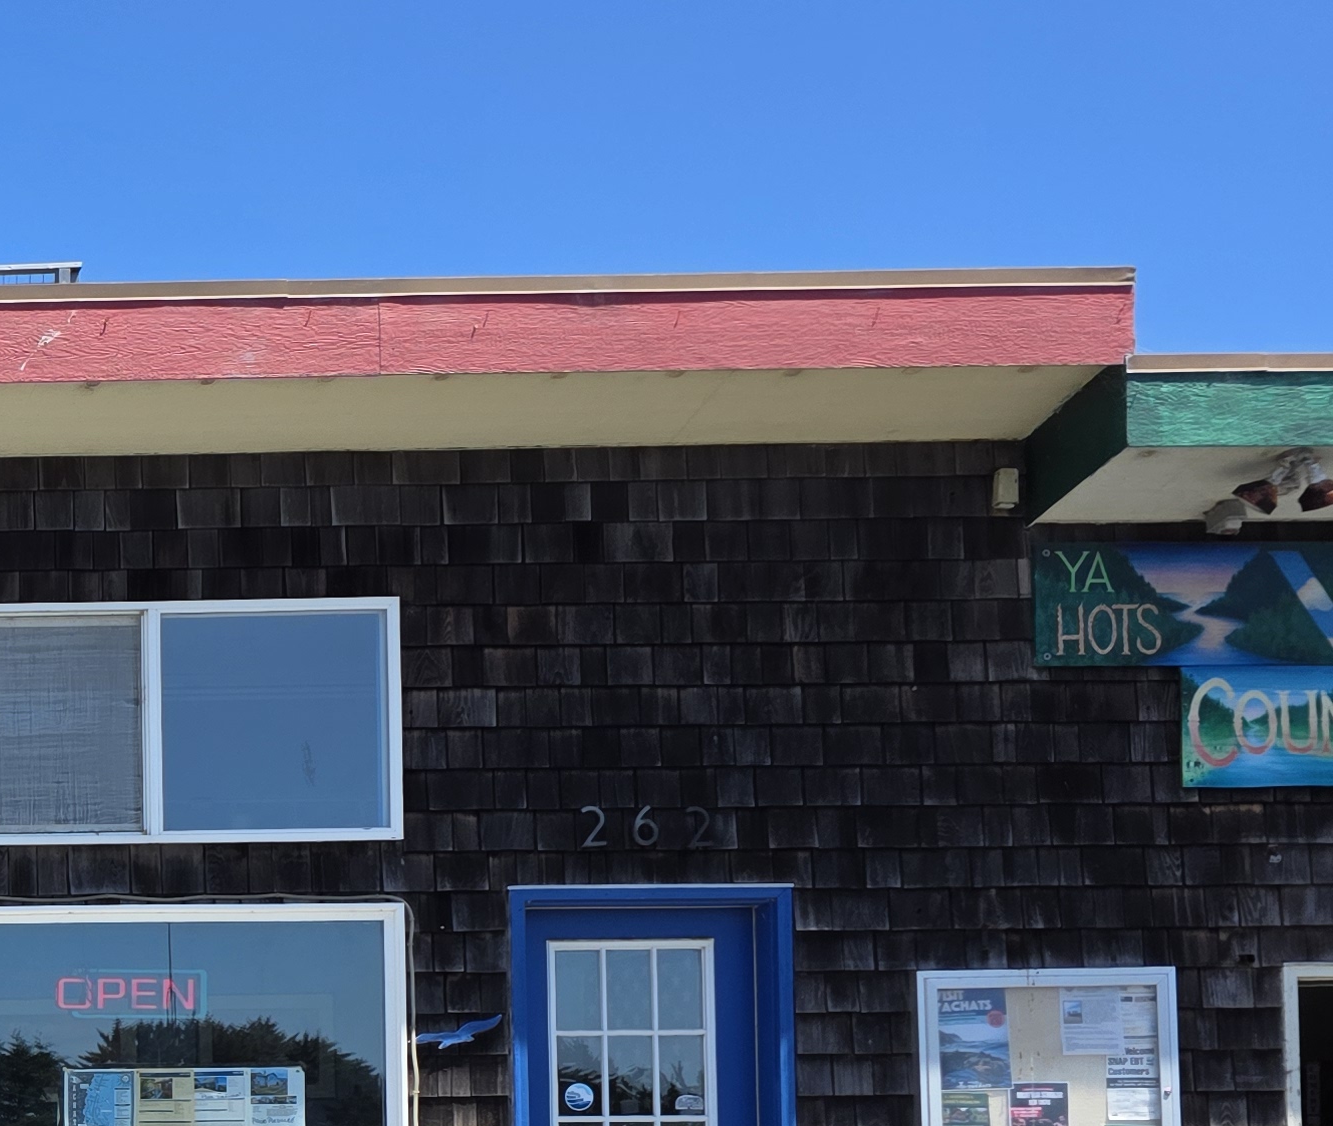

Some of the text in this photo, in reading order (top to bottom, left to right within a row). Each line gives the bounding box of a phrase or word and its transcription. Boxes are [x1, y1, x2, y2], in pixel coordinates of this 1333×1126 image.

[1054, 550, 1115, 594] YA
[1054, 602, 1163, 657] HOTS
[580, 804, 715, 848] 262
[55, 976, 196, 1010] OPEN
